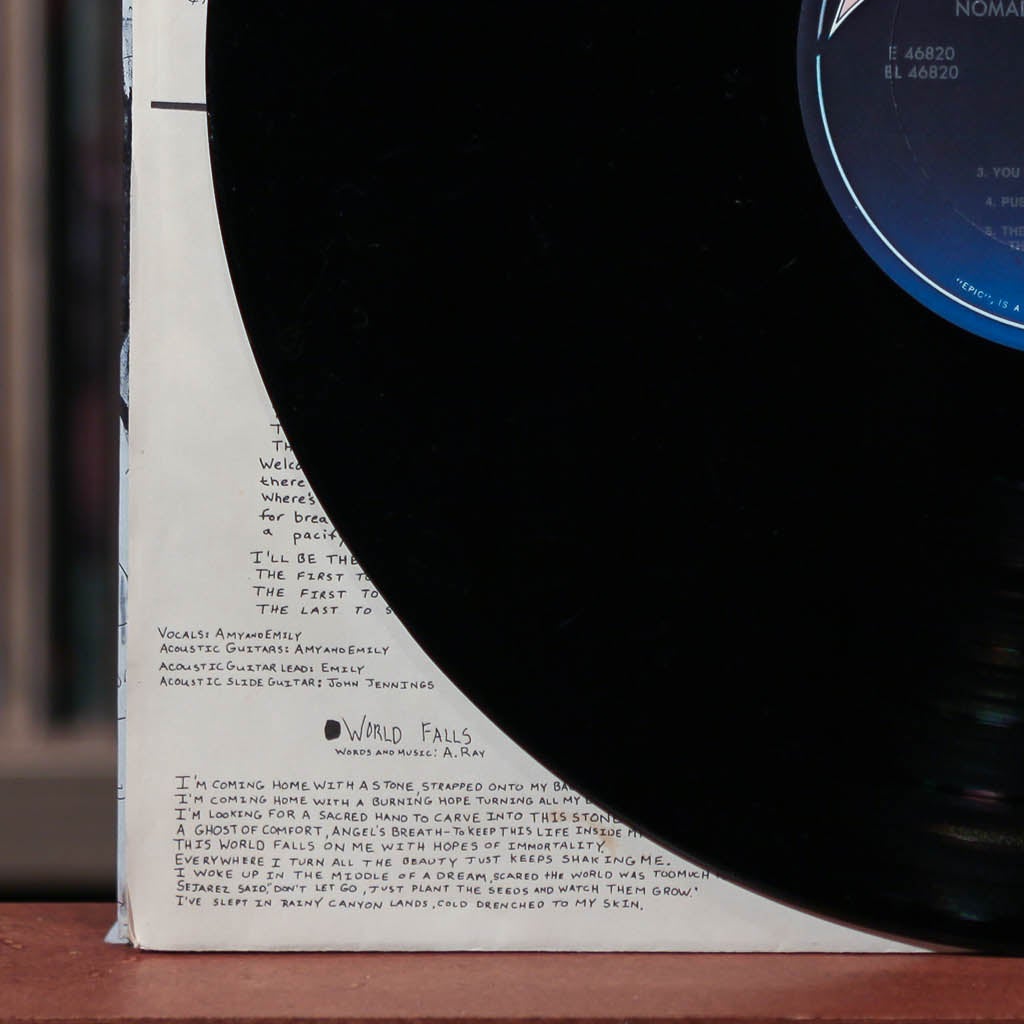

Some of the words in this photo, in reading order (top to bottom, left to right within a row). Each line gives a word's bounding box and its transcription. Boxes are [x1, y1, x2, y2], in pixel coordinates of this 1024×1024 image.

[904, 46, 956, 60] 46820
[907, 65, 958, 80] 46820
[993, 168, 1020, 178] YOU
[260, 476, 305, 487] there
[261, 492, 315, 505] Where's
[253, 586, 285, 597] THE
[300, 589, 347, 599] FIRST
[361, 589, 378, 598] TO
[160, 676, 222, 687] ACOUSTIC
[227, 677, 263, 687] SLIDE
[268, 677, 322, 688] GUITAR:
[327, 678, 358, 687] JOHN
[365, 679, 434, 689] JENNINGS
[342, 715, 402, 744] WORLD
[422, 722, 471, 745] FALLS
[335, 748, 371, 756] WORDS
[173, 839, 211, 850] THIS
[219, 839, 264, 851] WORLD
[274, 840, 315, 851] FALLS
[324, 842, 345, 852] ON
[352, 843, 374, 853] ME
[381, 842, 425, 852] WITH
[434, 841, 478, 851] HOPES
[175, 853, 264, 866] EVERYWHERE
[272, 858, 280, 868] I
[289, 858, 324, 866] TURN
[332, 858, 353, 866] ALL
[362, 859, 392, 867] THE
[403, 857, 457, 868] BEAUTY
[465, 855, 501, 864] JUST
[511, 854, 552, 864] KEEPS
